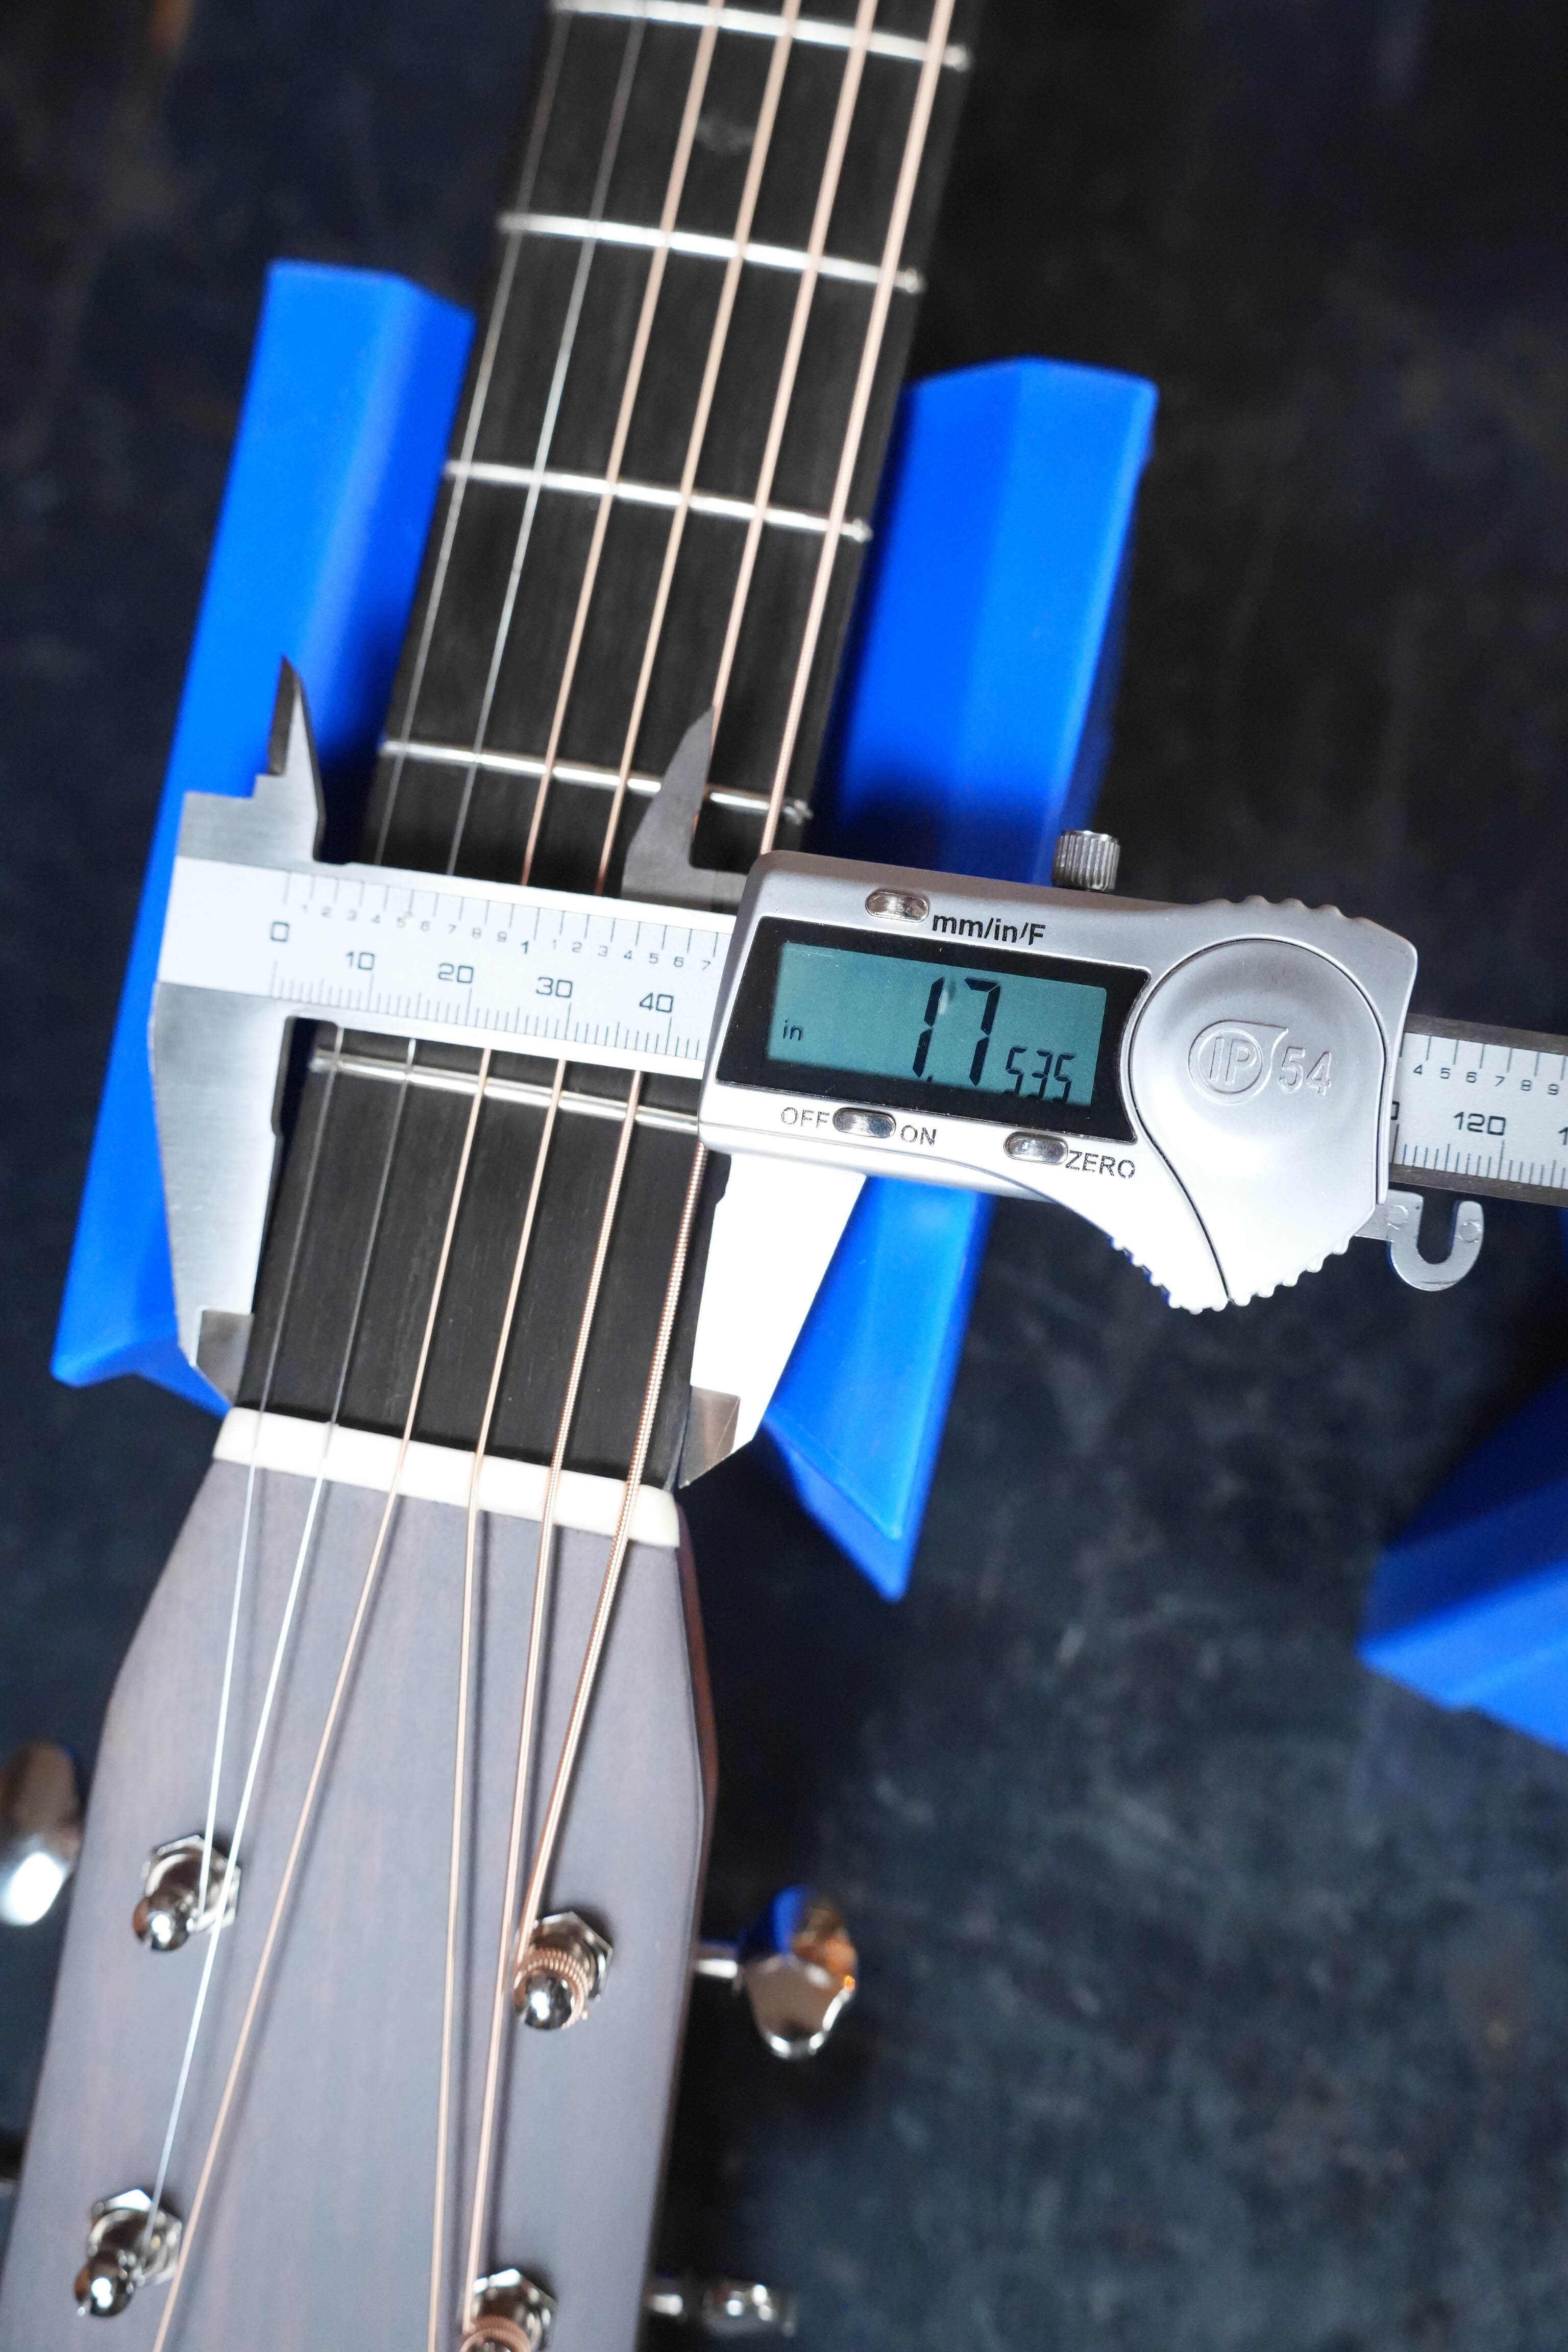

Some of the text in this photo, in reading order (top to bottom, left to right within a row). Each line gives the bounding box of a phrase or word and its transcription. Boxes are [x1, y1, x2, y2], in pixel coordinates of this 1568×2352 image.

[372, 915, 381, 924] 4
[397, 917, 406, 928] 5
[420, 921, 430, 932] 6
[448, 924, 457, 935] 7
[472, 927, 482, 939] 8
[497, 931, 508, 943] 9
[521, 941, 529, 954] 1
[552, 940, 557, 949] 1
[572, 942, 582, 953] 2
[598, 946, 608, 957] 3
[624, 950, 632, 960] 4
[649, 952, 658, 964] 5
[674, 957, 684, 968] 6
[701, 960, 710, 971] 7
[932, 914, 1046, 945] mm/in/F
[270, 921, 674, 1013] 0 10 20 30 40
[782, 1020, 803, 1041] in
[1209, 1037, 1332, 1096] IP 54
[1413, 1064, 1559, 1095] 4 5 6 7 8 9
[780, 1107, 831, 1130] OFF
[1453, 1111, 1506, 1136] 120
[900, 1124, 938, 1147] ON
[1065, 1149, 1136, 1180] ZERO
